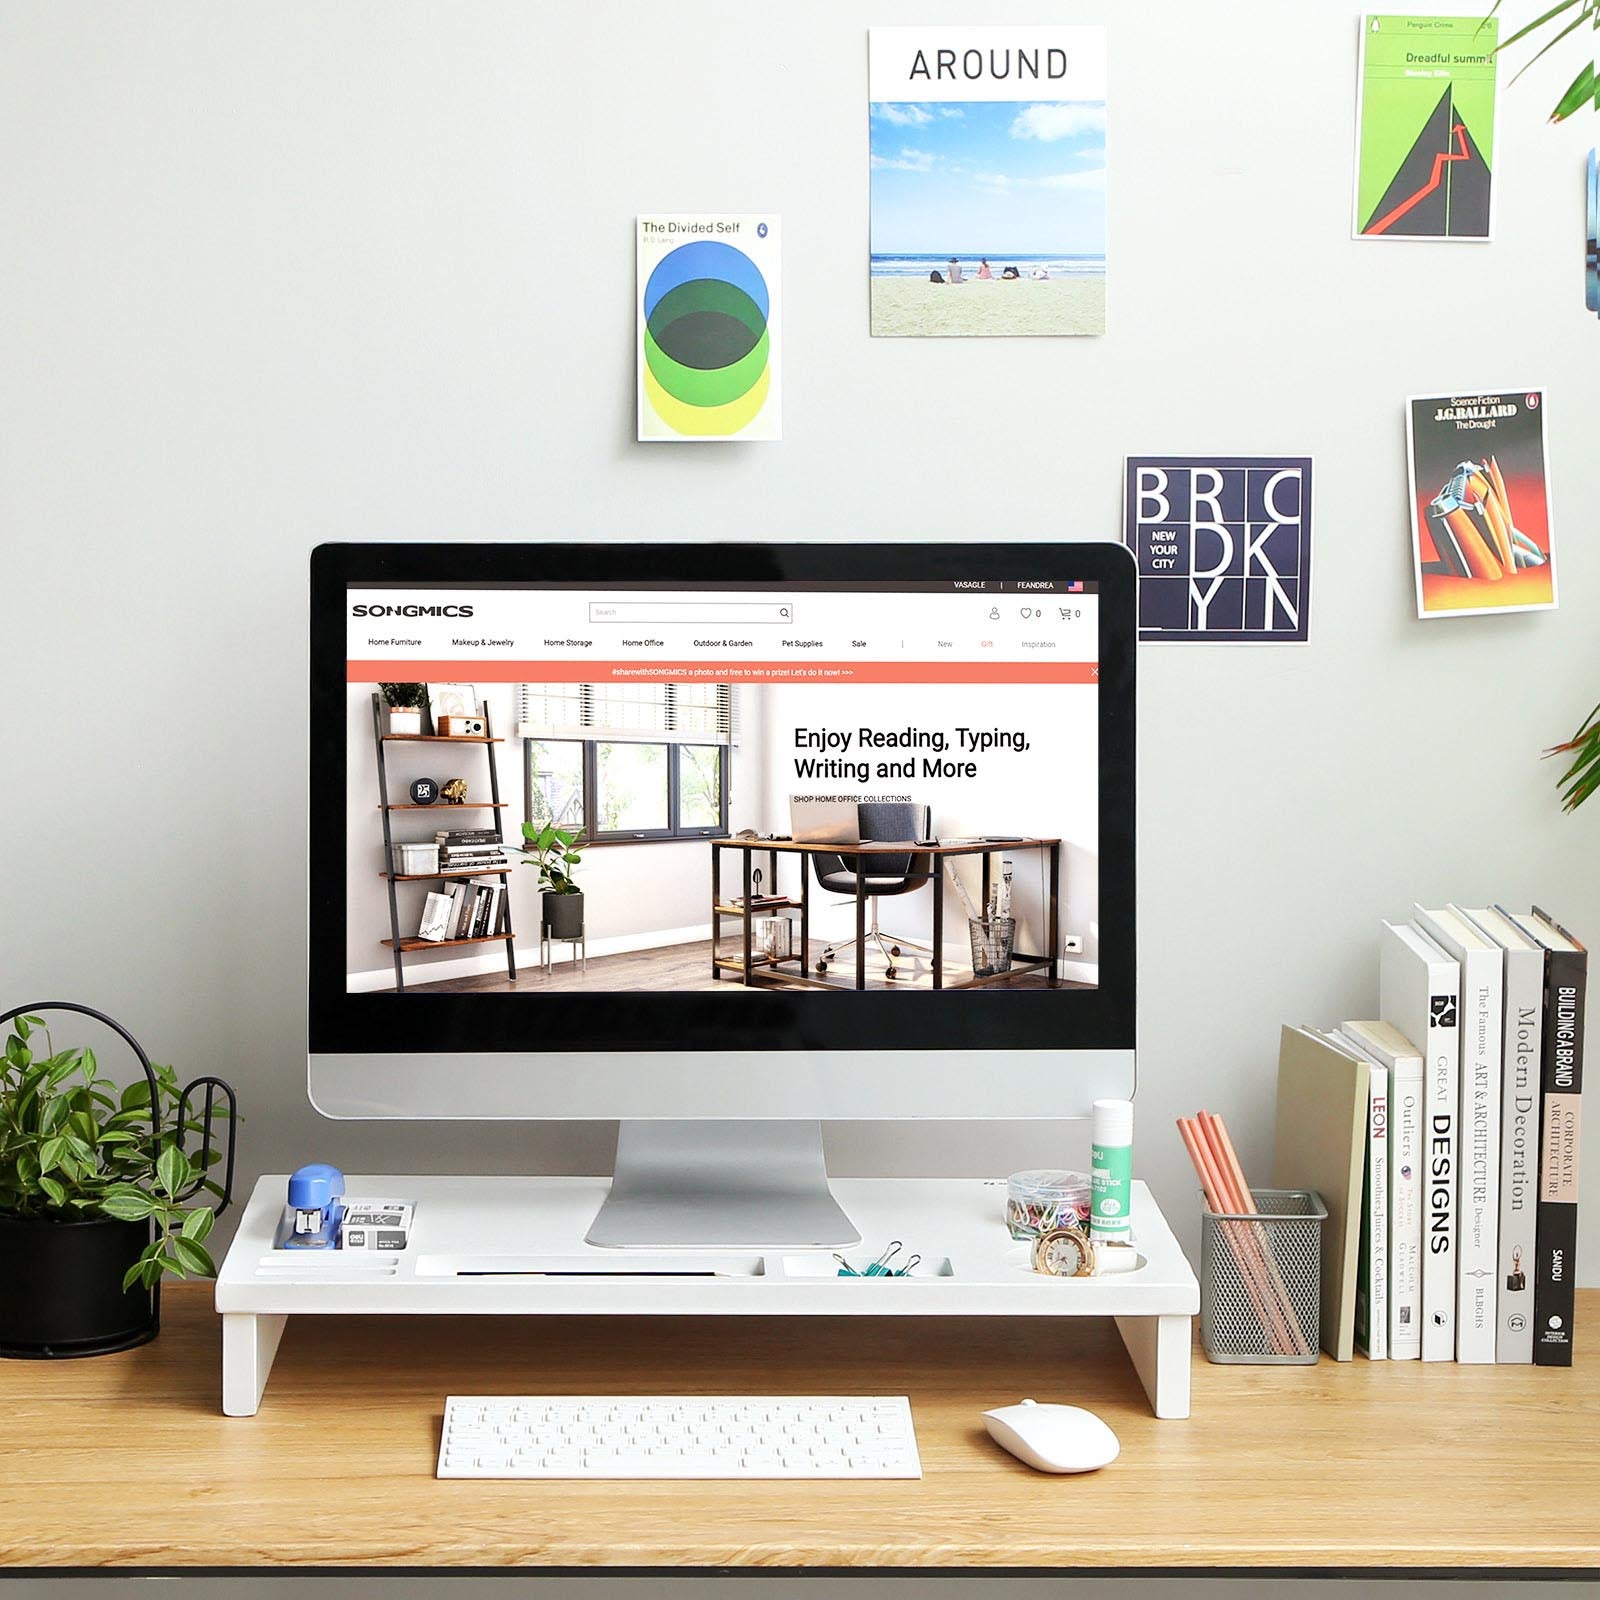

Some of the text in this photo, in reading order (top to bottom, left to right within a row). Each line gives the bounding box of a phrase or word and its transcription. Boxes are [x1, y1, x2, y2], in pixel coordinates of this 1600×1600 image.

[909, 48, 1068, 80] AROUND
[1406, 53, 1492, 64] Dreadful summ
[643, 222, 740, 233] The Divided Self
[1450, 396, 1501, 406] Science Fiction
[1455, 419, 1496, 430] The Drought
[1152, 531, 1176, 541] NEW
[1150, 544, 1178, 555] YOUR
[1152, 558, 1175, 569] CITY
[954, 581, 1054, 589] VASAGLE FEANDREA
[352, 604, 474, 618] SONGMICS
[595, 608, 617, 616] Search
[1035, 609, 1042, 618] 0
[1075, 609, 1081, 618] 0
[391, 638, 422, 646] Furniture
[452, 639, 479, 648] Makeup
[487, 639, 514, 648] Jewelry
[566, 639, 593, 648] Storage
[622, 639, 664, 647] Home Office
[793, 640, 823, 649] Supplies
[1021, 640, 1056, 649] Inspiration
[612, 668, 687, 677] #sharewithSONGMICS
[694, 668, 714, 678] photo
[715, 668, 728, 676] and
[729, 668, 743, 676] free
[744, 668, 751, 676] to
[752, 668, 765, 676] win
[771, 668, 790, 678] prize!
[791, 668, 806, 676] Let's
[807, 668, 816, 676] do
[824, 668, 840, 676] now!
[794, 727, 1031, 753] Enjoy Reading, Typing,
[794, 757, 977, 783] Writing and More
[793, 795, 912, 803] SHOP HOME OFFICE COLLECTIONS
[1437, 1056, 1447, 1102] GREAT
[1511, 1007, 1536, 1211] Modern Decoration
[1373, 1097, 1386, 1138] LEON
[1473, 986, 1489, 1248] The Famous ART & ARCHITECTURE Designer
[1402, 1096, 1415, 1157] Outliers
[1548, 1101, 1562, 1198] ARCHITECTURE
[1562, 1111, 1575, 1186] CORPORATE
[1431, 1115, 1451, 1254] DESIGNS
[1374, 1246, 1384, 1254] &
[1551, 1249, 1564, 1281] SANDU
[1374, 1257, 1385, 1304] Cocktails
[1475, 1288, 1484, 1329] BLBGHS
